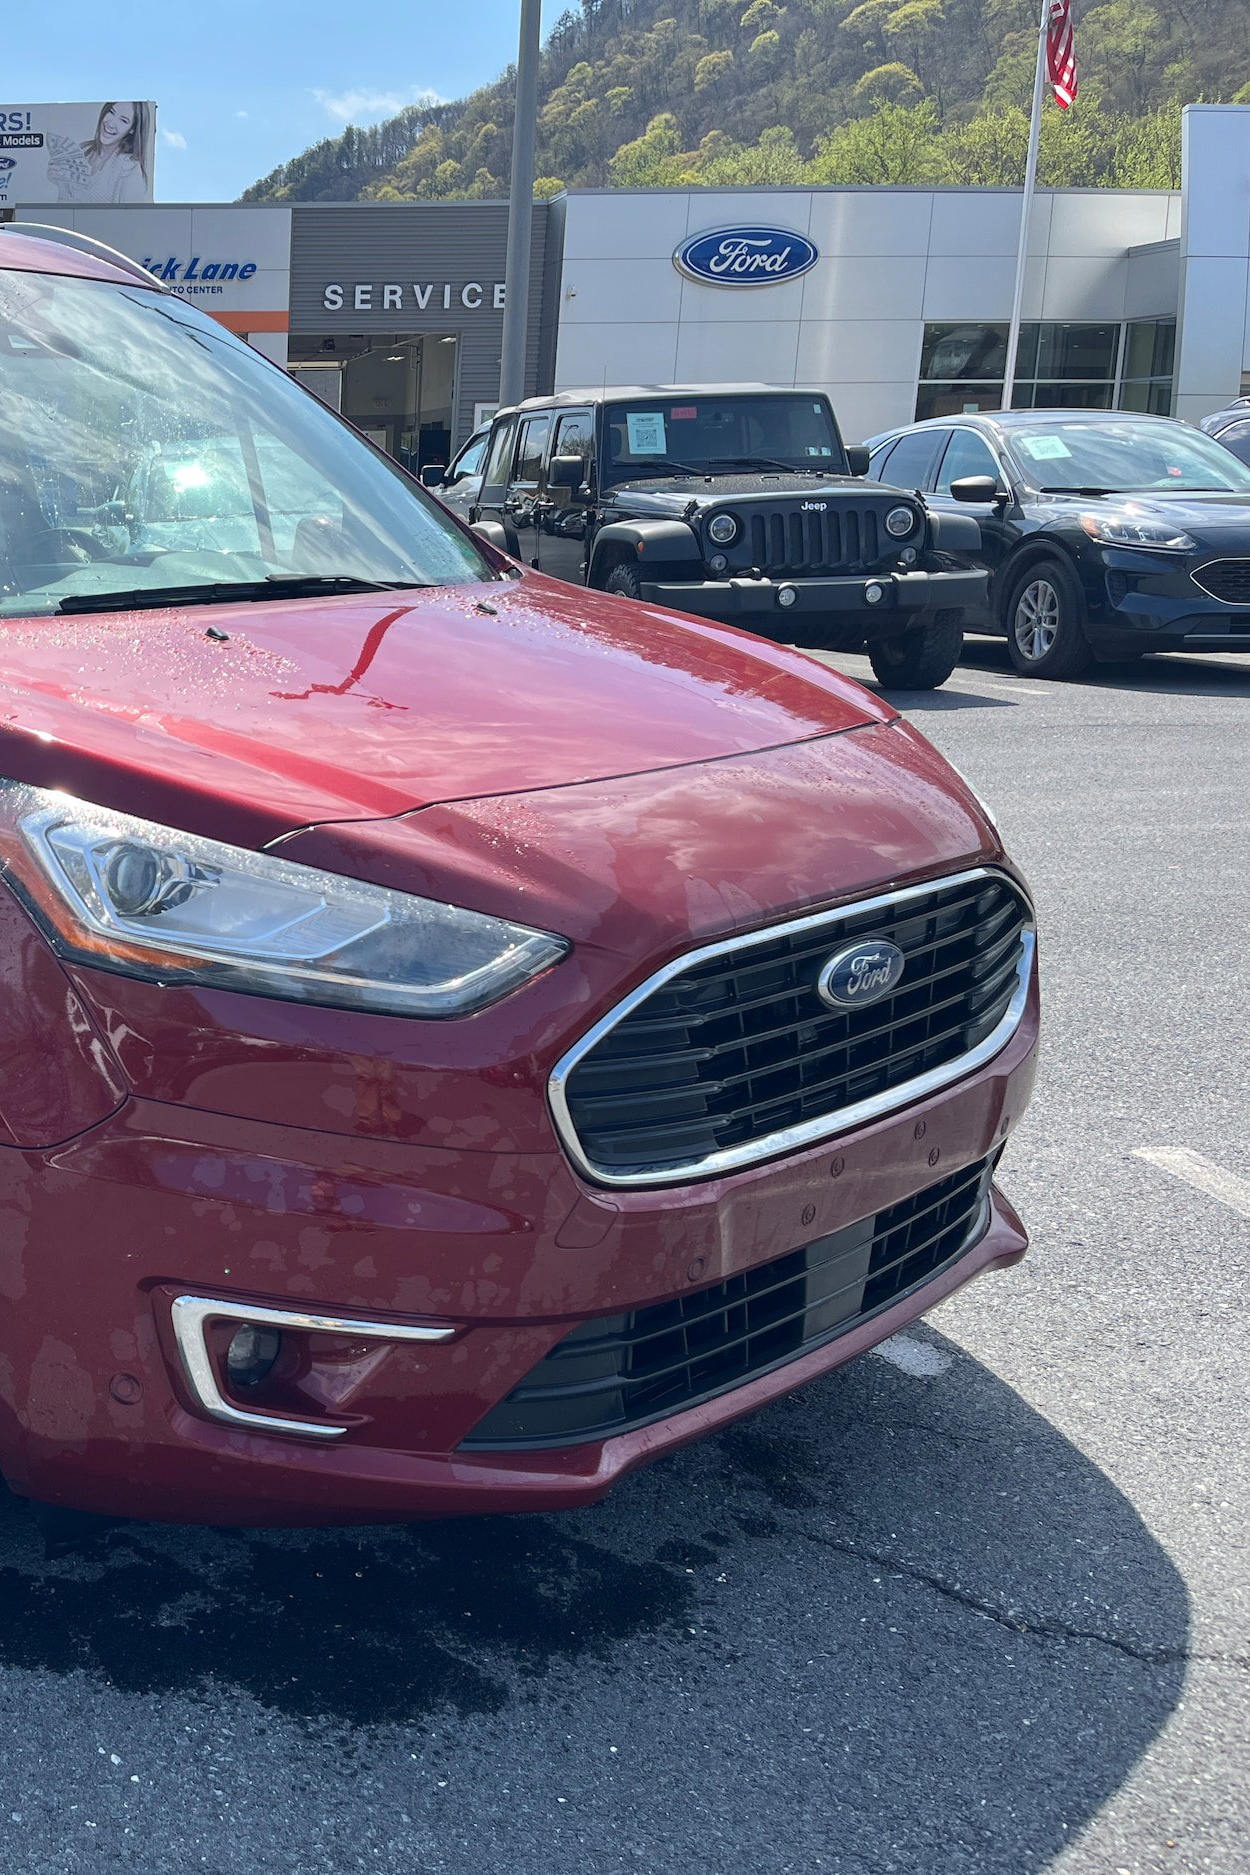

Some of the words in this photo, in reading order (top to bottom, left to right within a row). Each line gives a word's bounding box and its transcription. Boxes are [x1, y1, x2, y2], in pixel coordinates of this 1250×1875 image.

[3, 135, 40, 146] Models
[709, 238, 792, 273] Ford
[141, 257, 182, 280] ick
[183, 257, 257, 280] Lane
[186, 286, 223, 294] CENTER
[323, 283, 506, 310] SERVICE
[801, 501, 827, 511] Jeep
[846, 952, 892, 995] Ford
